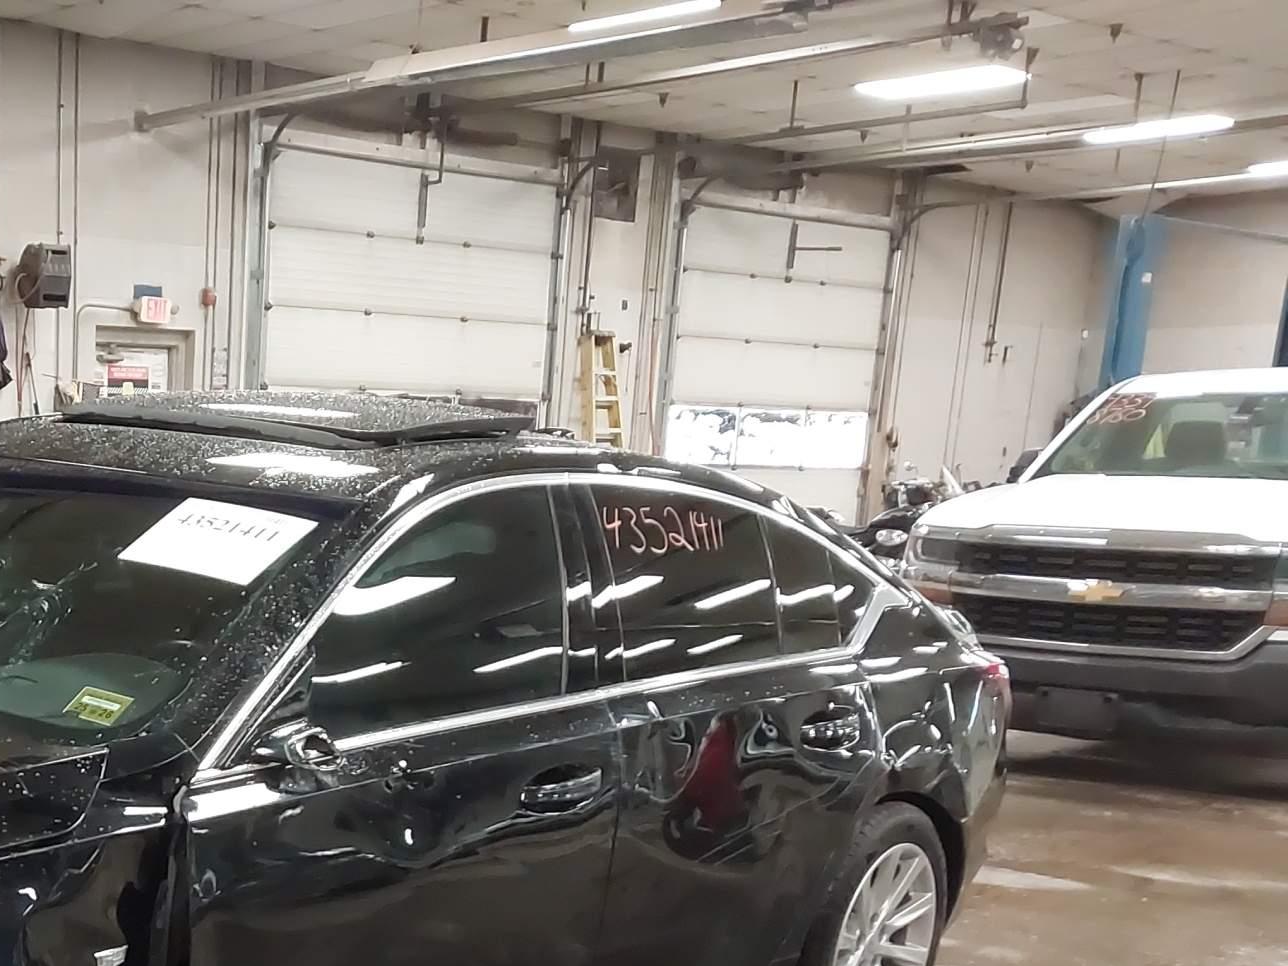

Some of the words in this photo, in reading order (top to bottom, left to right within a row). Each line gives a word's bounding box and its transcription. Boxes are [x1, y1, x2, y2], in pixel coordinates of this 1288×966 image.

[146, 299, 169, 321] EXIT
[177, 514, 280, 541] 43521411
[603, 506, 724, 554] 43521411
